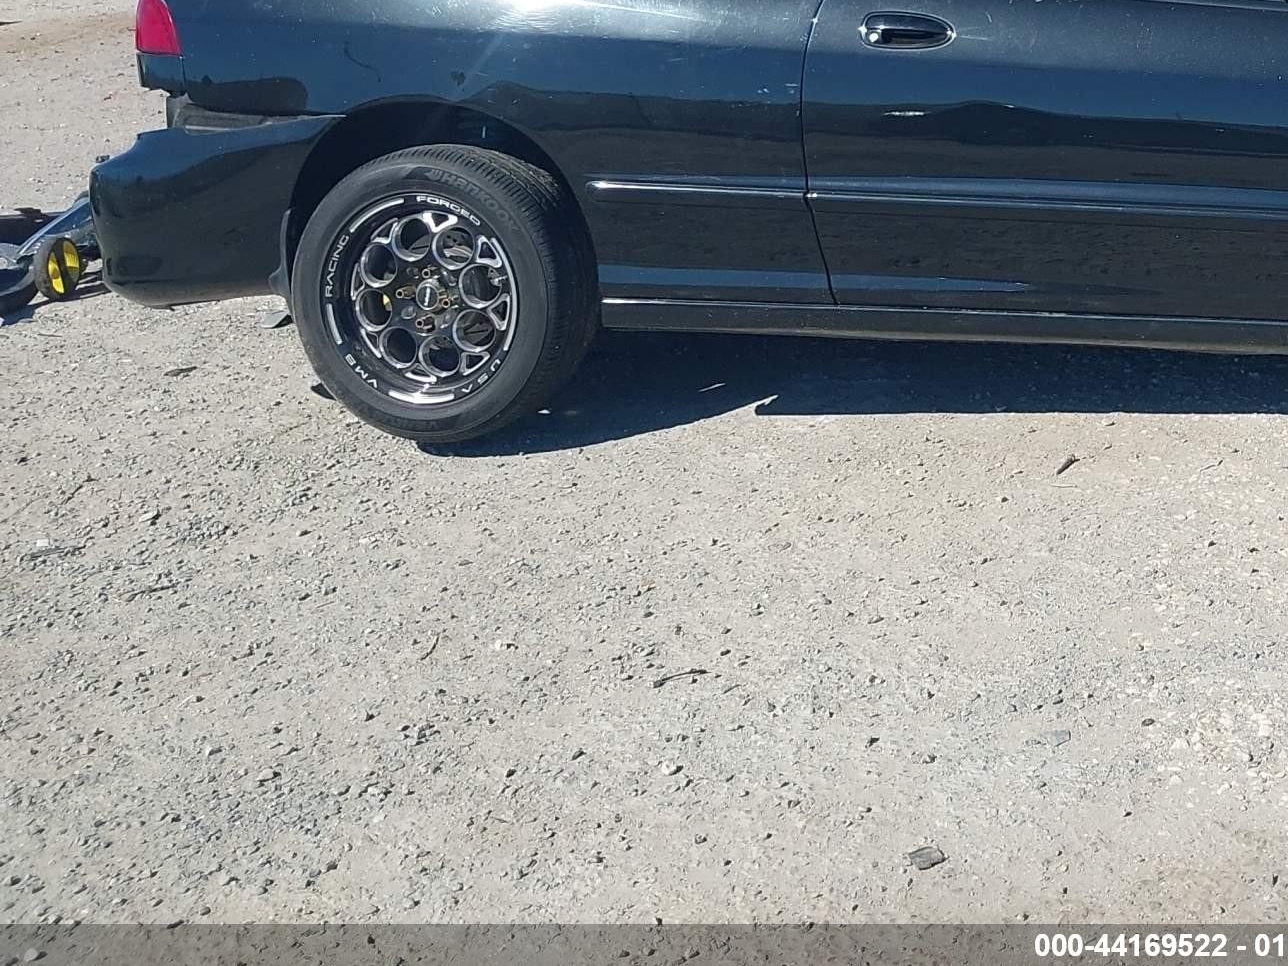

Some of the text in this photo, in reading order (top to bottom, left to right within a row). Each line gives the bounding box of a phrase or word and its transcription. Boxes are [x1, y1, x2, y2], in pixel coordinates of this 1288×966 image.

[416, 195, 481, 227] FORGED
[324, 234, 350, 298] RACING
[344, 352, 380, 390] VMS
[461, 357, 501, 394] USA
